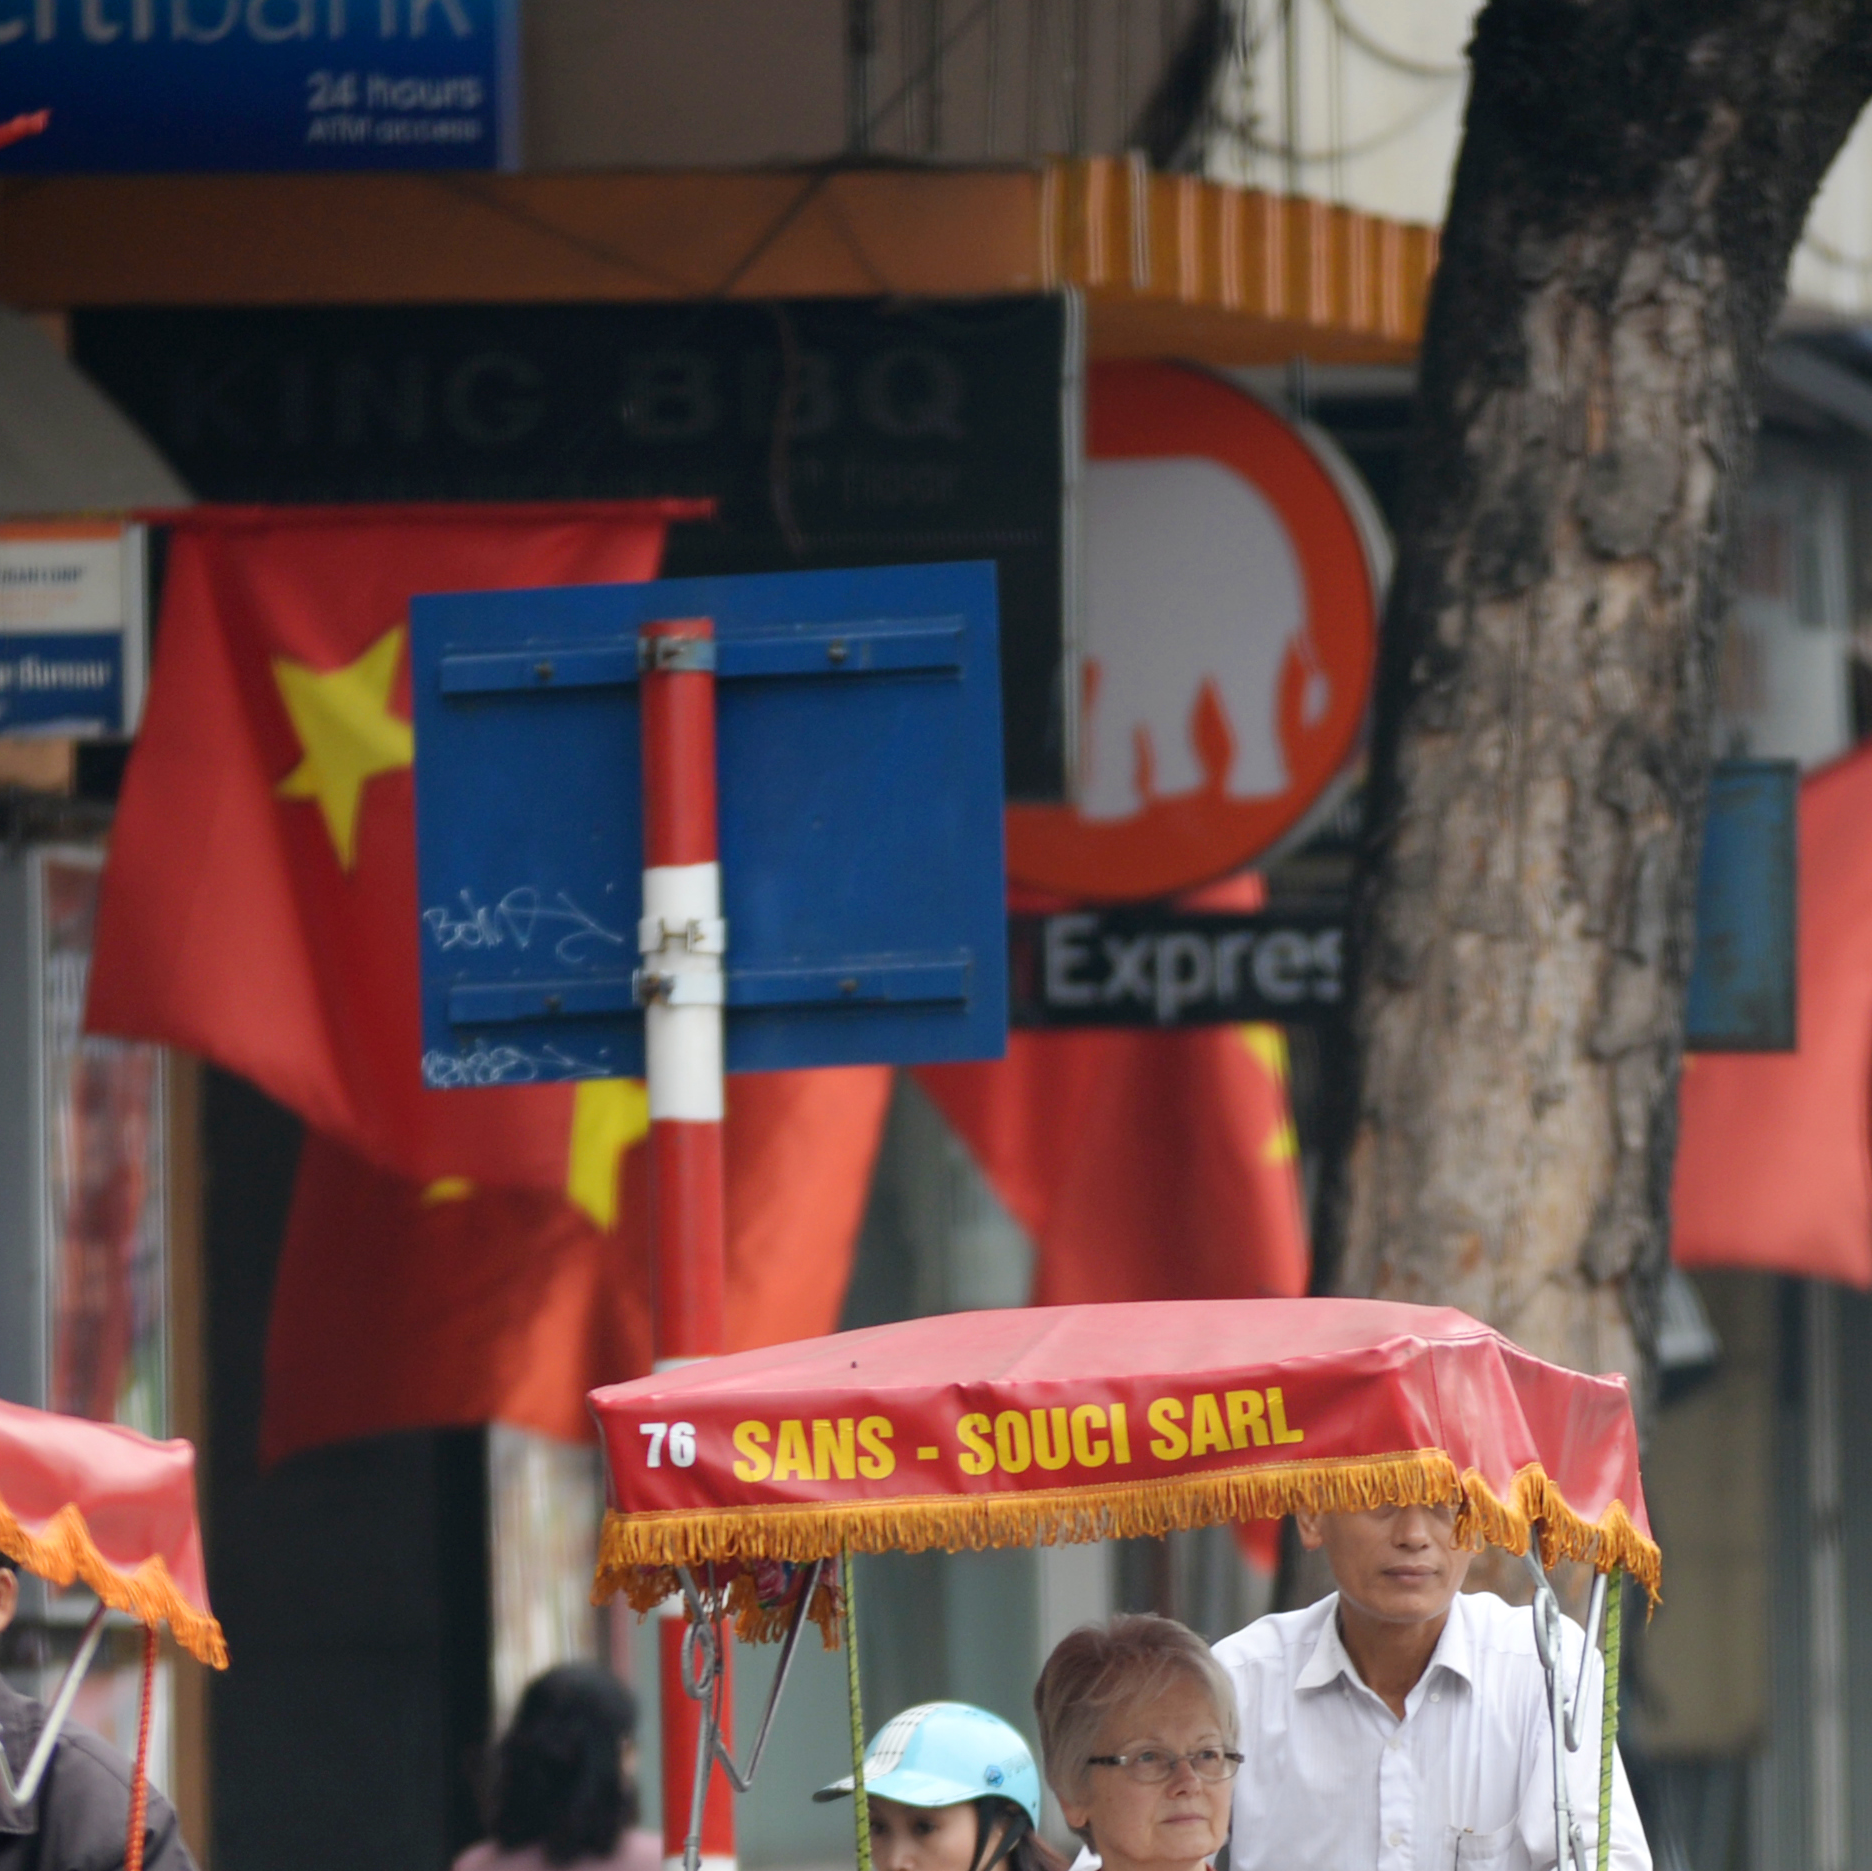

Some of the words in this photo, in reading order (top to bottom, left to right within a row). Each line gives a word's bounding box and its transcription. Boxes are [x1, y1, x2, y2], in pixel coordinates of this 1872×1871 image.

[307, 70, 360, 112] 24
[366, 73, 483, 112] hours
[167, 350, 547, 445] KING
[619, 346, 973, 444] BBQ
[639, 1421, 697, 1469] 76
[732, 1415, 896, 1483] SANS
[955, 1402, 1132, 1477] SOUCI
[1146, 1386, 1305, 1463] SARL
